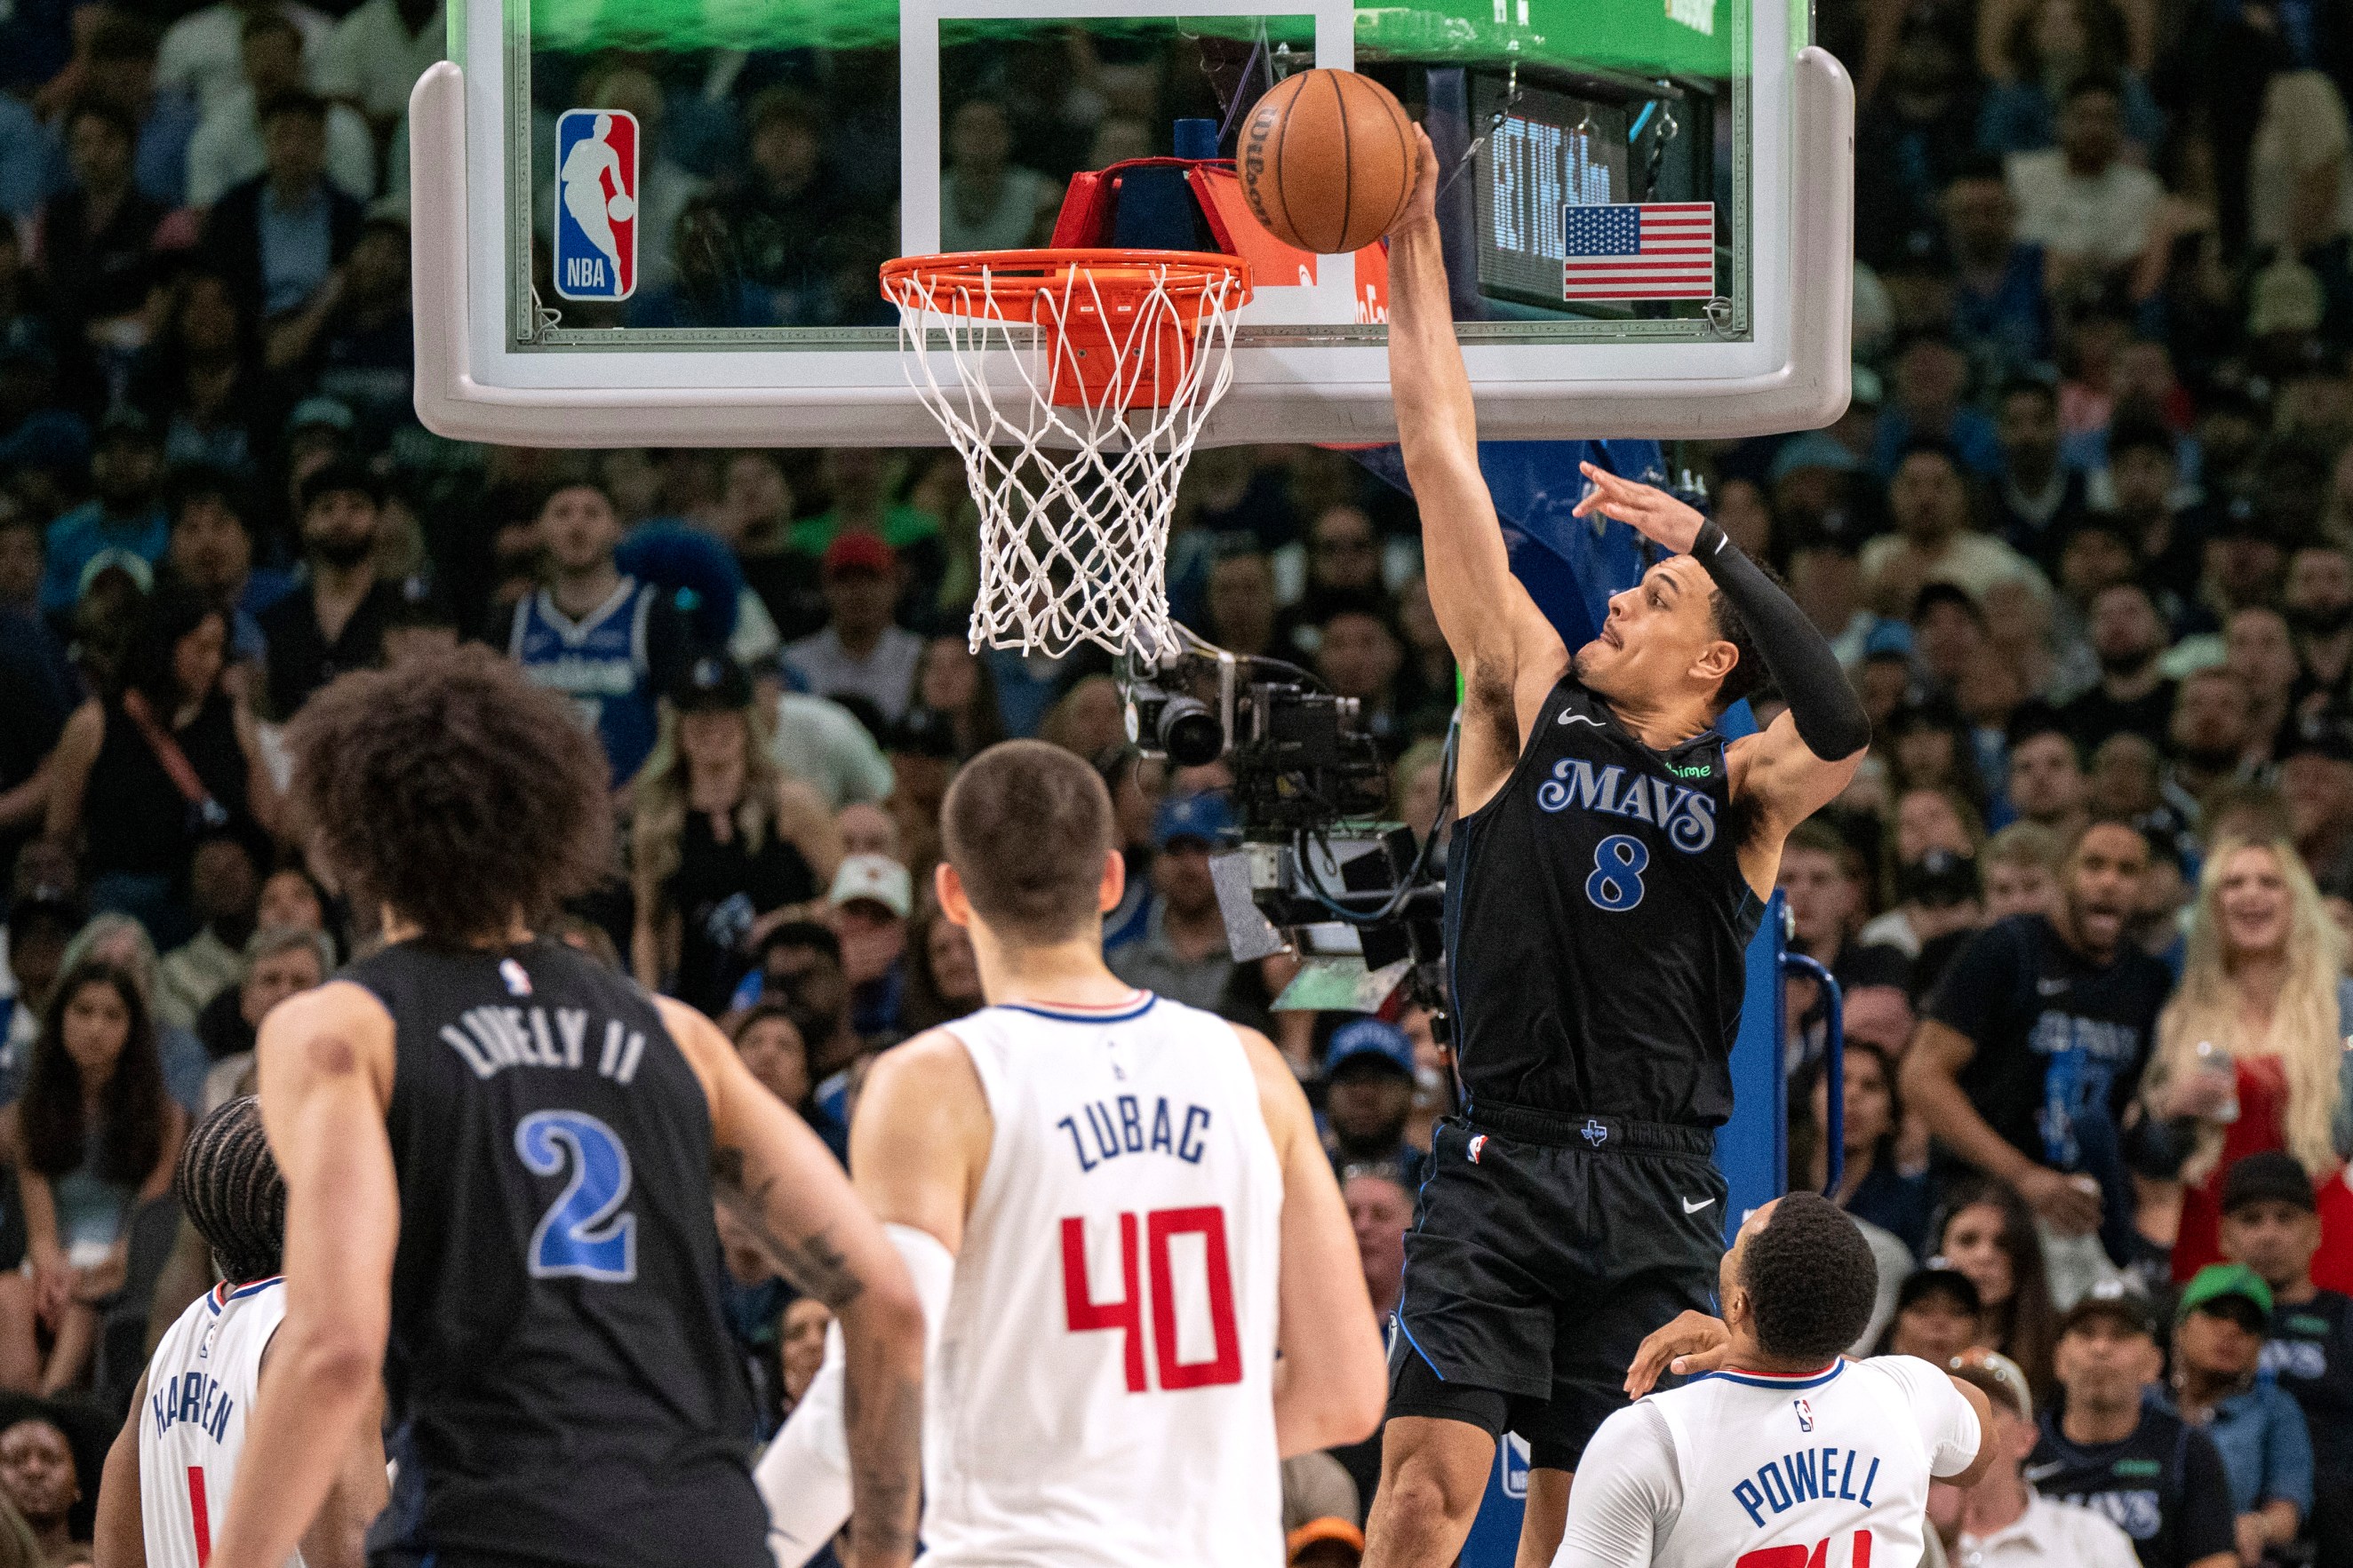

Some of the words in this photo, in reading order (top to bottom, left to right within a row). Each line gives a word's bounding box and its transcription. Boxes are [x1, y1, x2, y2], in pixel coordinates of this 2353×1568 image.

[567, 258, 605, 288] NBA
[1537, 758, 1716, 854] MAVS
[1585, 833, 1650, 912] 8
[440, 1006, 589, 1080] LOVELY
[597, 1019, 646, 1086] II
[1057, 1094, 1212, 1173] ZUBAC
[514, 1110, 637, 1282] 2
[1060, 1206, 1243, 1393] 40
[153, 1372, 234, 1445] HAREN
[187, 1466, 211, 1568] 1
[1732, 1447, 1880, 1528] POWELL
